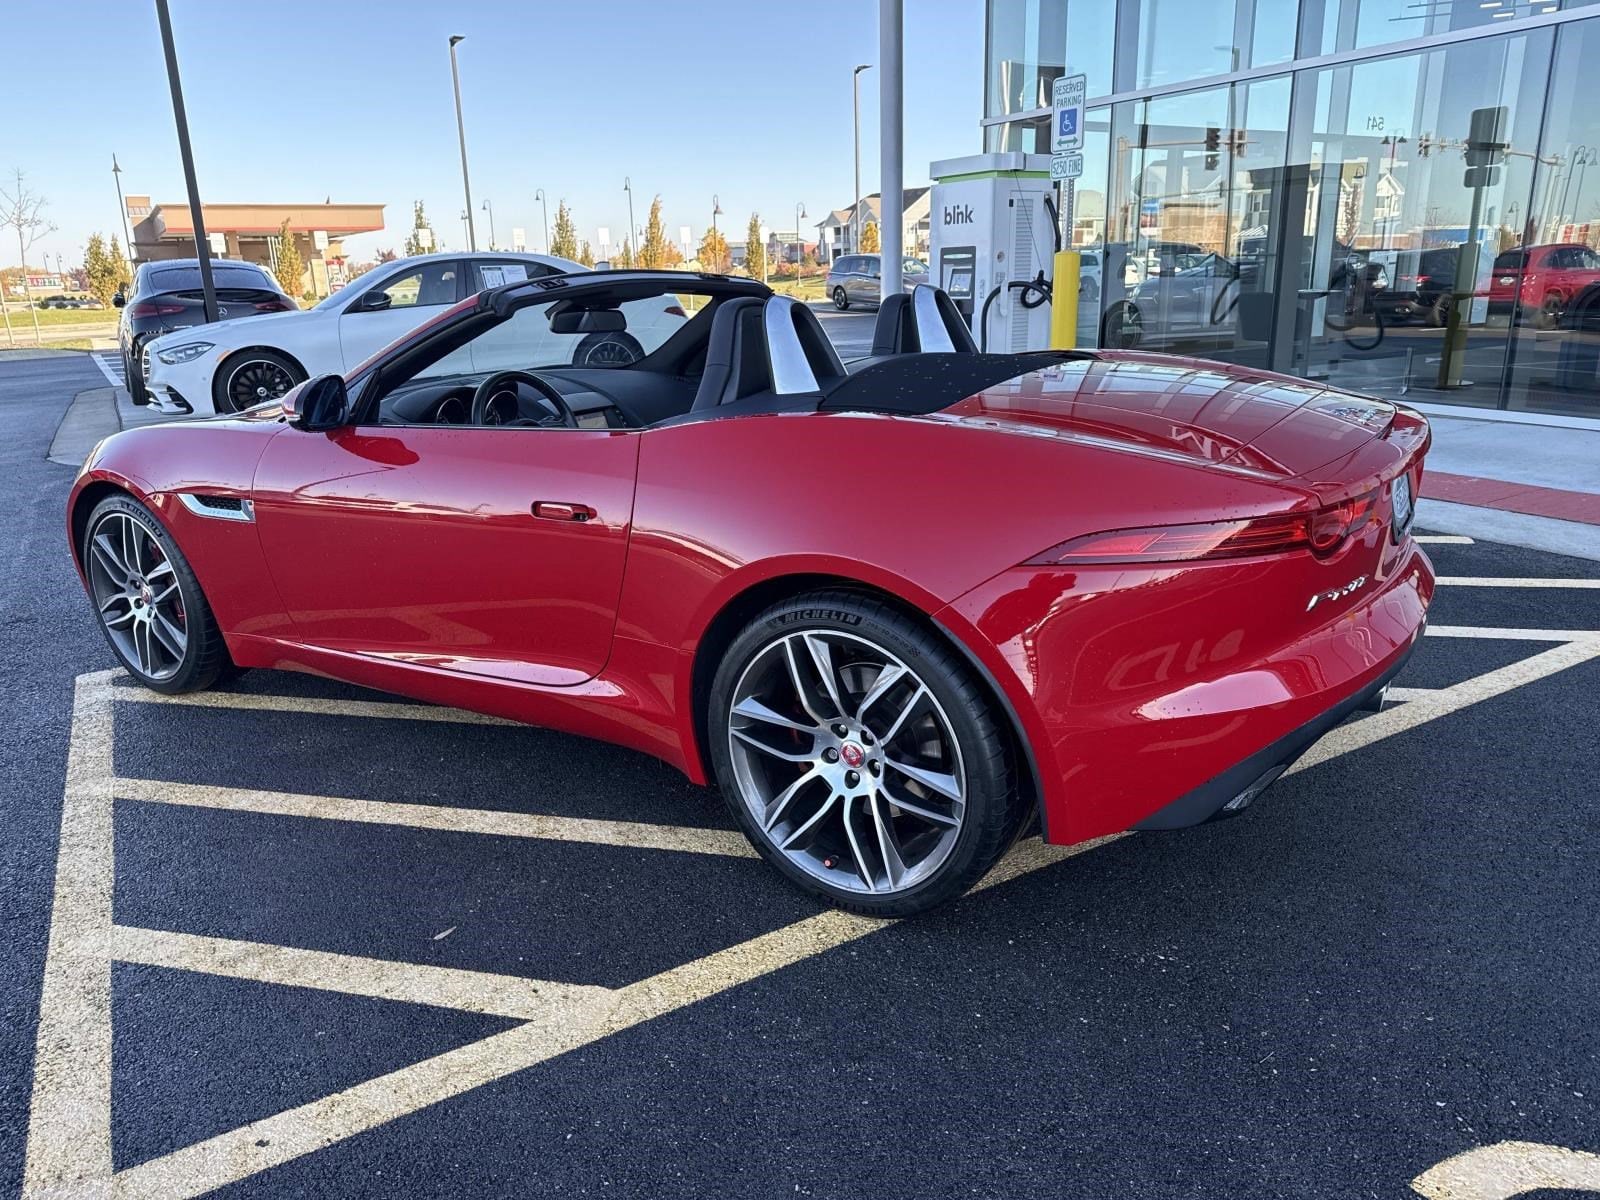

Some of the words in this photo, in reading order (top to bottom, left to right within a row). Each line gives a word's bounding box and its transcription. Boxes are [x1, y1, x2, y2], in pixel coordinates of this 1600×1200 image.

[1056, 82, 1084, 95] RESERVED
[1056, 95, 1082, 108] PARKING
[1053, 160, 1067, 175] $250
[1068, 159, 1081, 173] FINE
[944, 204, 974, 225] blink
[784, 610, 858, 624] MICHELIN
